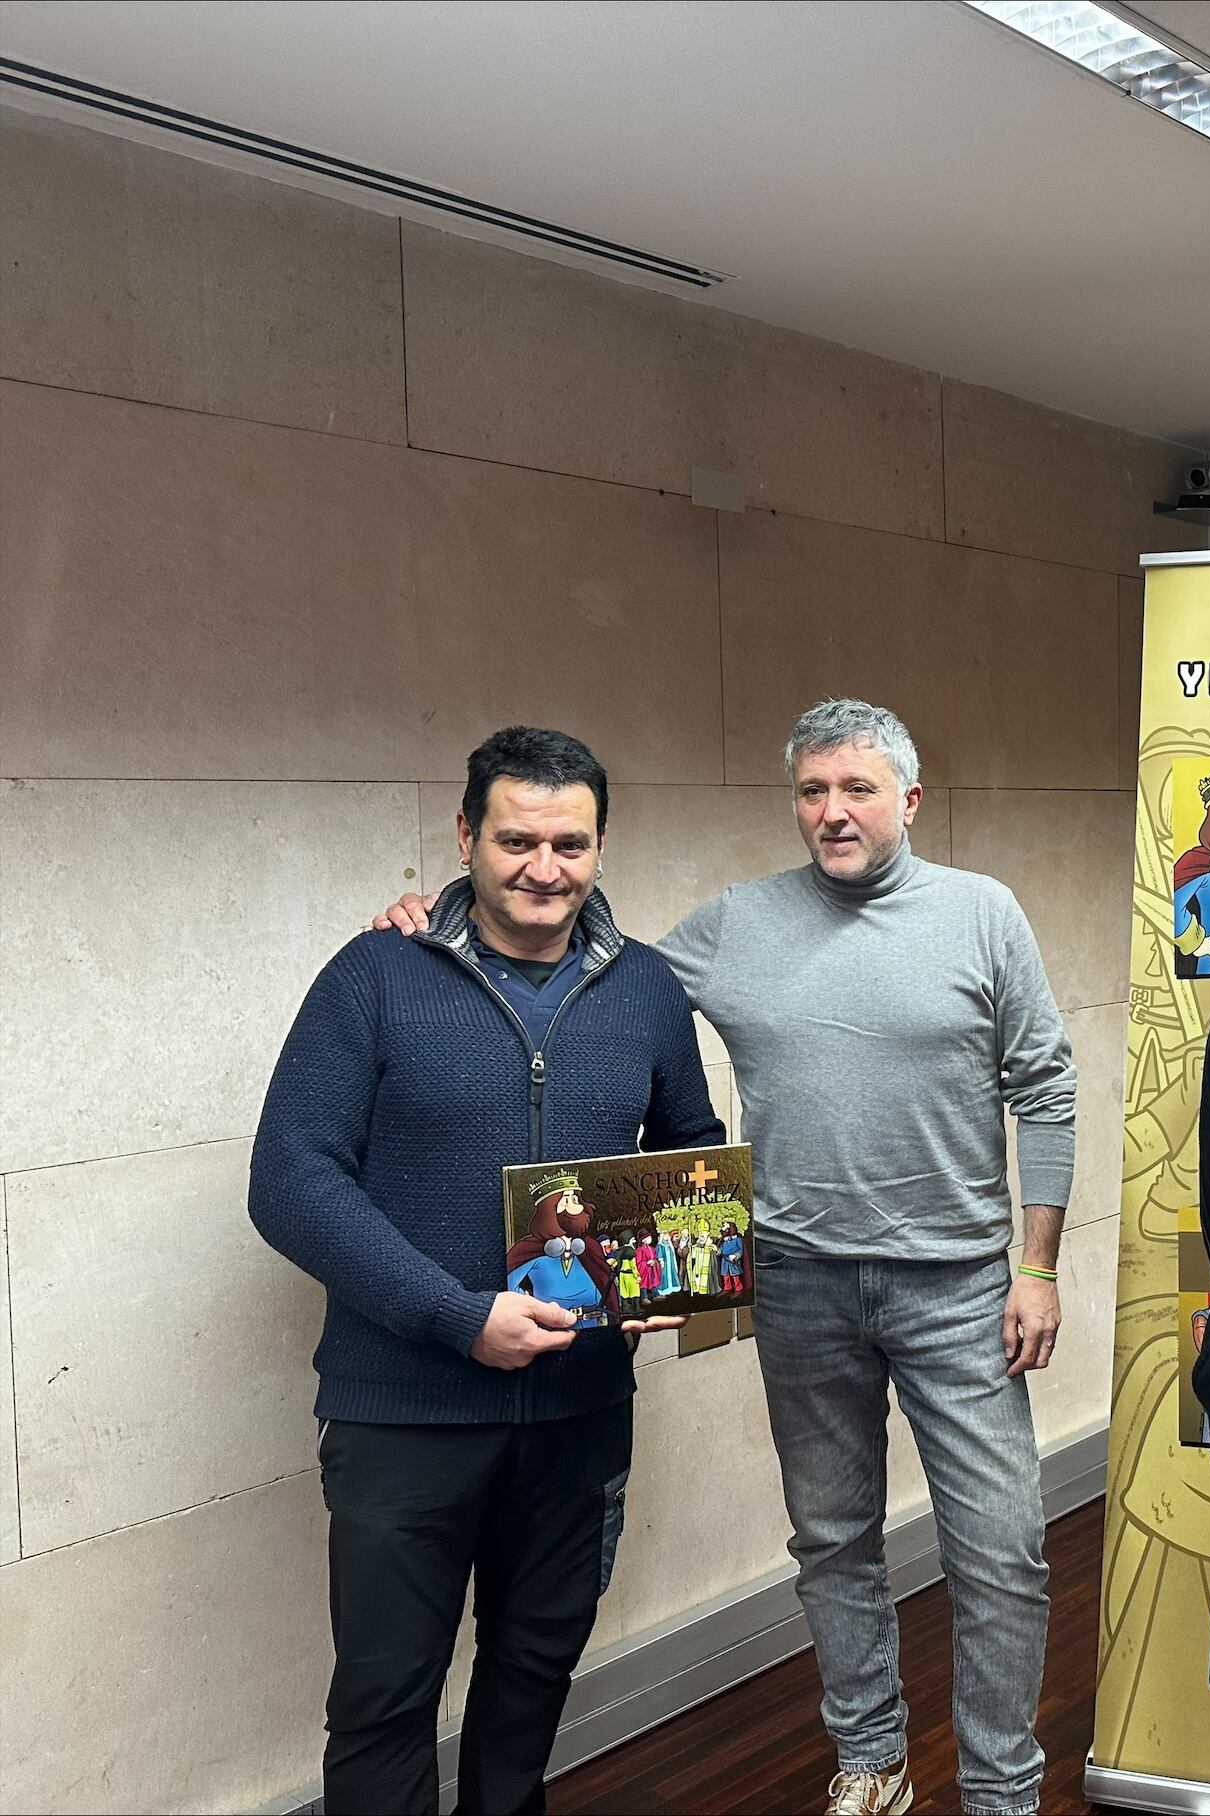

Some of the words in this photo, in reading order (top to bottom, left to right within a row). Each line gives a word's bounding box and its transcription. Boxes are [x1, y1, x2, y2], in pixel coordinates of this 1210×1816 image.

[1178, 661, 1204, 697] Y
[594, 1170, 689, 1197] SANCHO
[636, 1181, 741, 1212] RAMÍREZ
